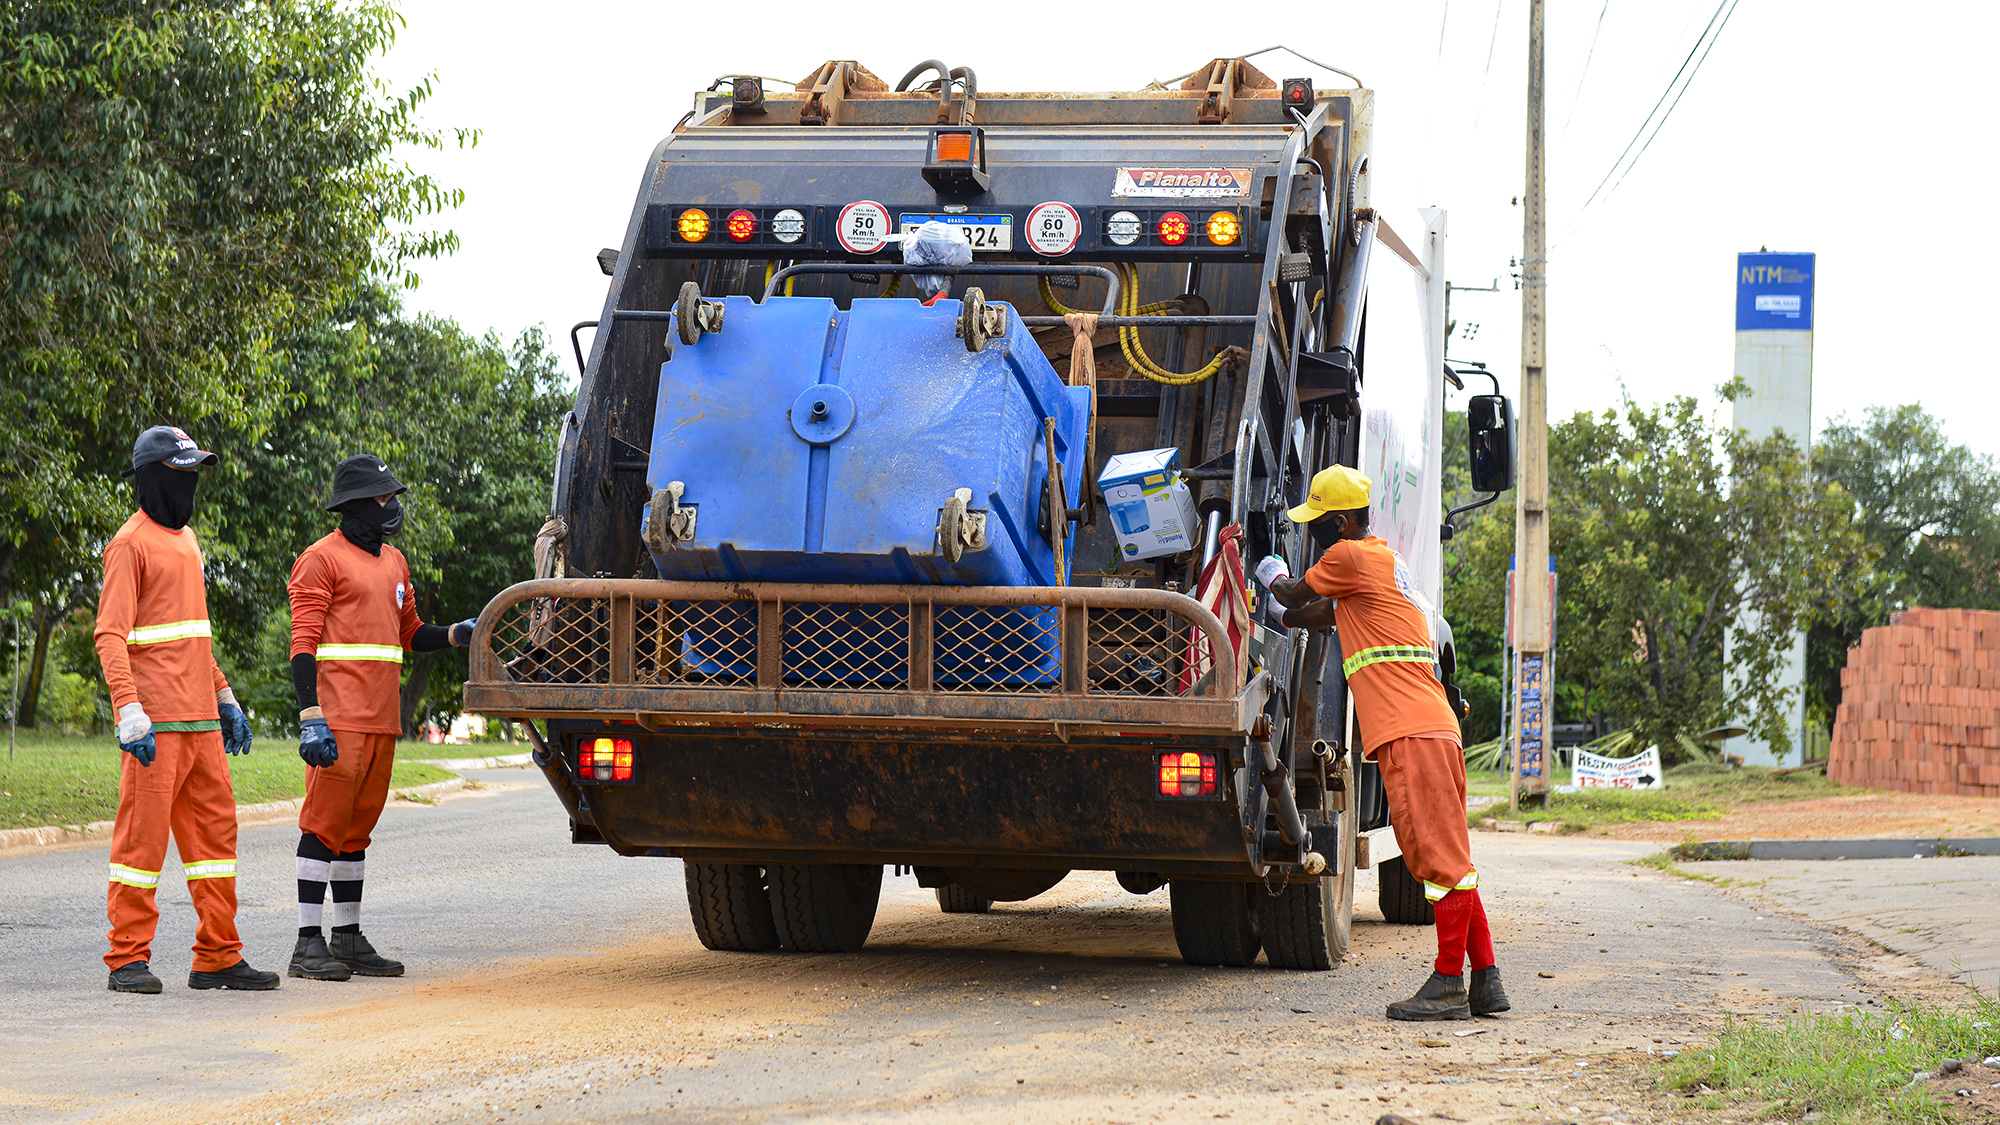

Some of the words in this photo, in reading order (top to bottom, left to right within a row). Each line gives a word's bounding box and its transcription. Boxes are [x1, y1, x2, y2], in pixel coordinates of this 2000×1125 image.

[1138, 171, 1233, 187] Planalto
[855, 217, 874, 229] 50
[1043, 219, 1063, 230] 60
[852, 229, 875, 237] Km/h
[1741, 266, 1782, 284] NTM
